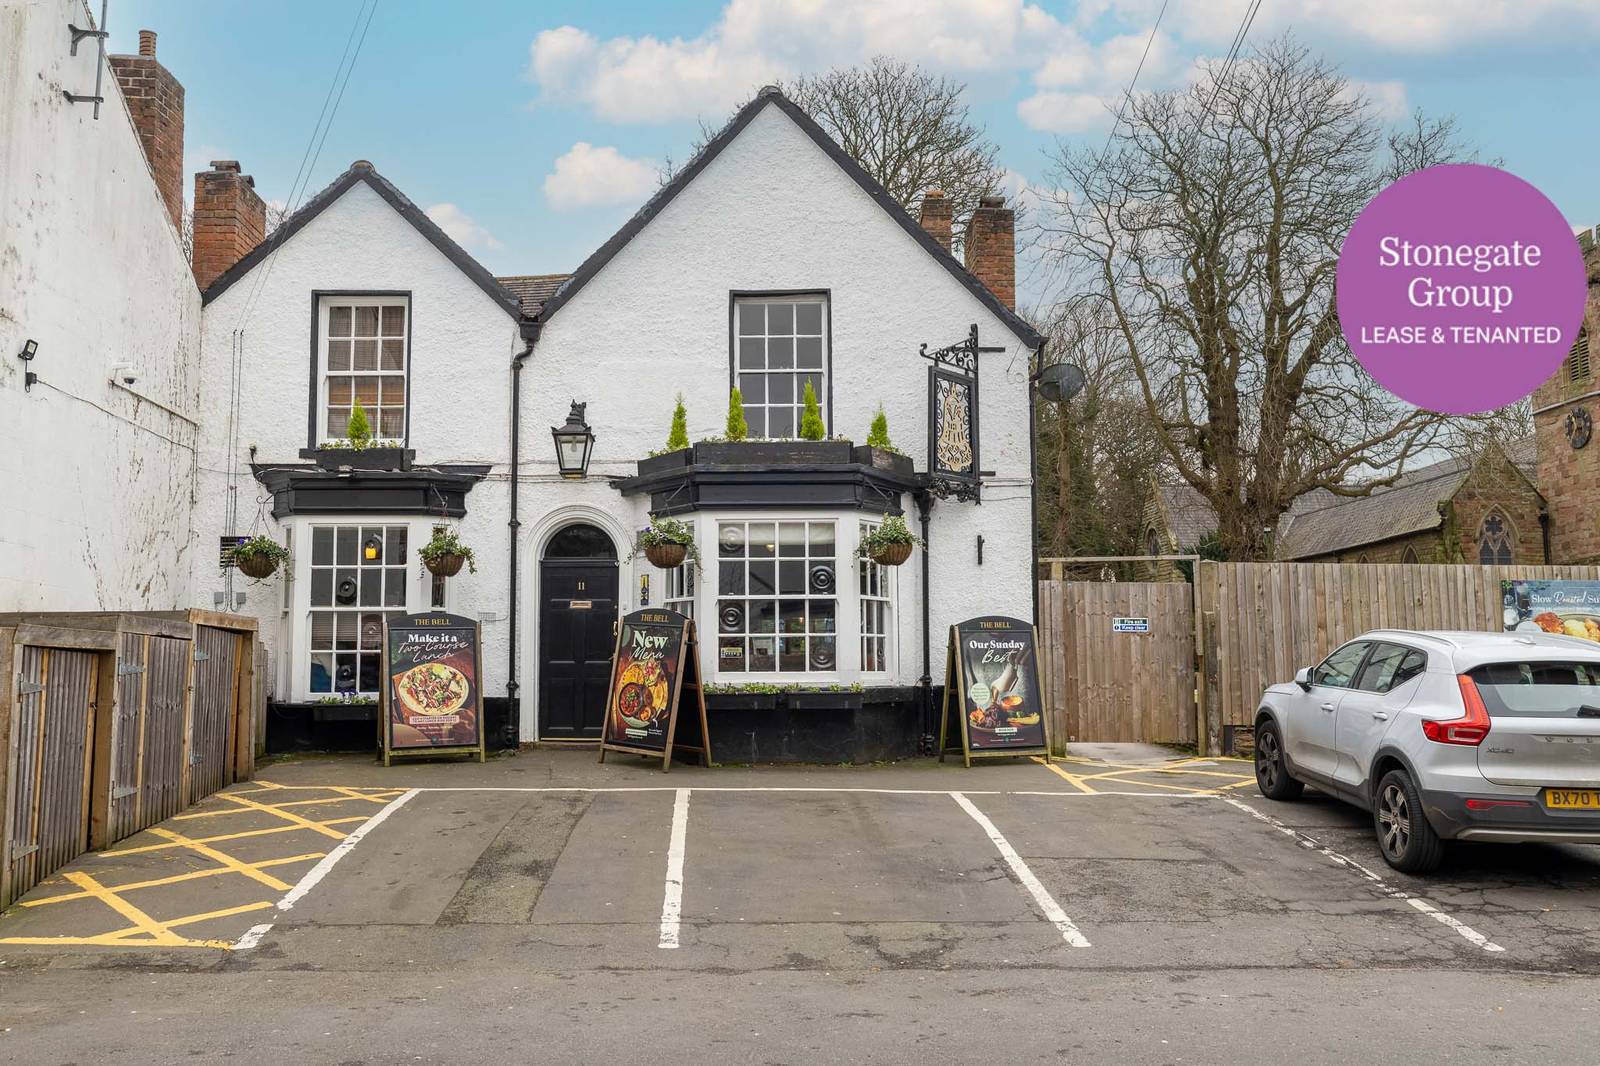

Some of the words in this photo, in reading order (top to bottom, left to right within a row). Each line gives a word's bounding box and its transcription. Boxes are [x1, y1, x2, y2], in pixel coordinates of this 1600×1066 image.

[578, 582, 585, 590] 11
[1531, 593, 1553, 603] Slow
[1553, 591, 1587, 605] Roasted
[415, 618, 429, 626] THE
[432, 618, 451, 626] BELL
[653, 614, 669, 622] BELL
[980, 621, 993, 629] THE
[994, 621, 1011, 629] BELL
[408, 633, 440, 643] Make
[441, 633, 449, 643] it
[450, 635, 457, 643] a
[632, 630, 668, 649] New
[969, 640, 988, 649] Our
[989, 640, 1025, 650] Sunday
[413, 648, 454, 662] Lunch
[629, 647, 665, 661] Menu
[981, 648, 1017, 664] Best
[1552, 791, 1590, 805] BX70
